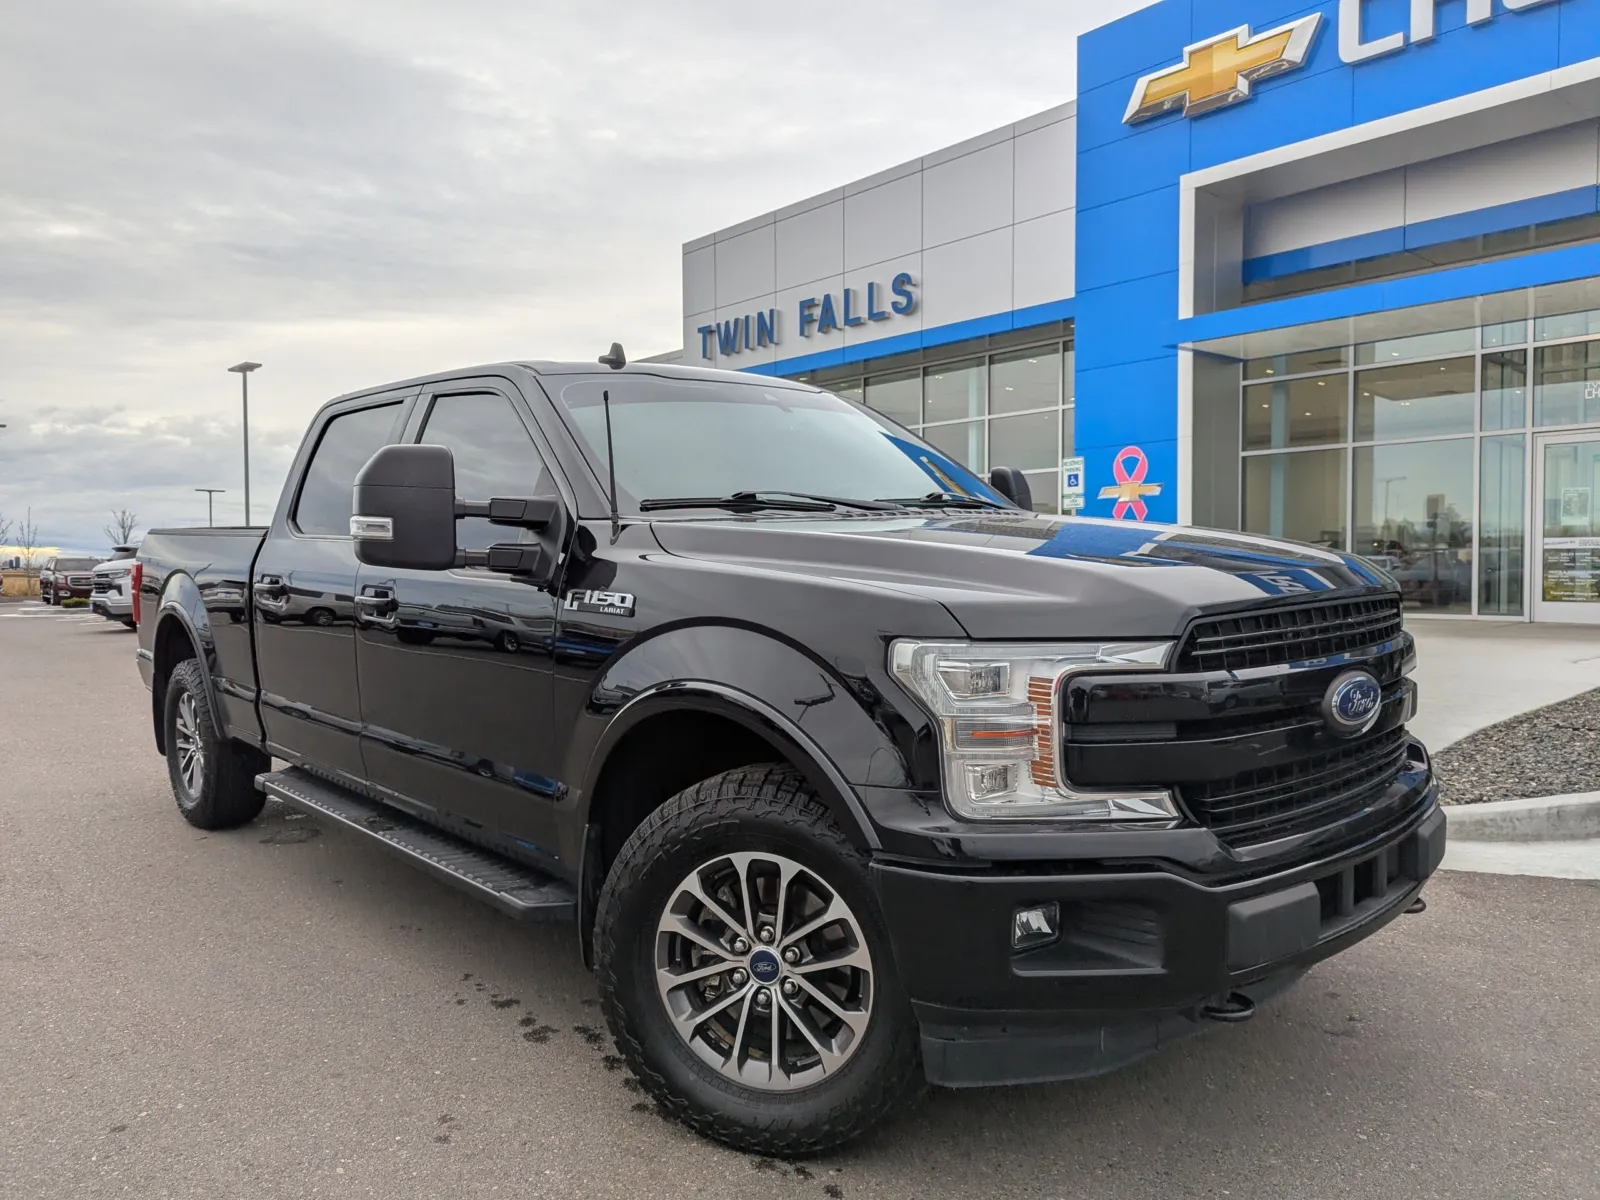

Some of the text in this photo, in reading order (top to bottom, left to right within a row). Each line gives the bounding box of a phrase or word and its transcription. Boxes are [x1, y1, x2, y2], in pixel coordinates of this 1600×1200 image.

[697, 272, 918, 360] TWIN FALLS
[600, 606, 624, 615] LARIAT
[1348, 688, 1375, 716] Ford
